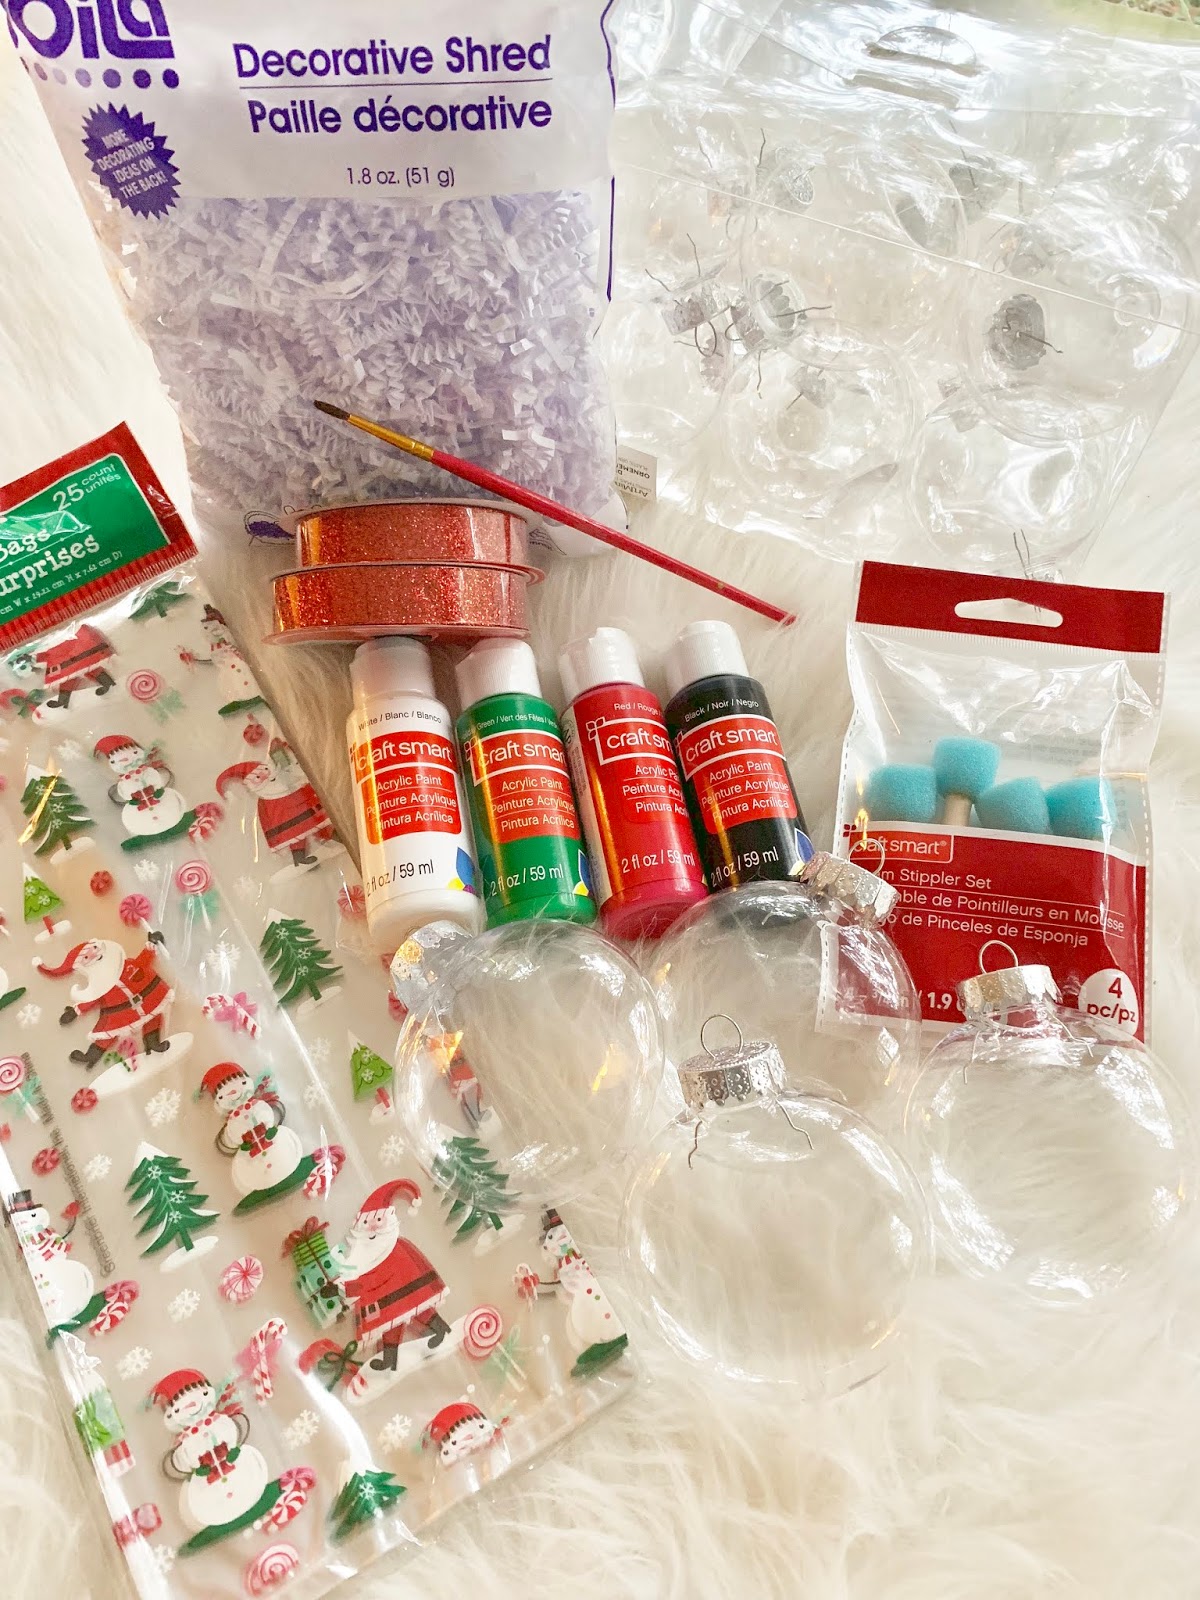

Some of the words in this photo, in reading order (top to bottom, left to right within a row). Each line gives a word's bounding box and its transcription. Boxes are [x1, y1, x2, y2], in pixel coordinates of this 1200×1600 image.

[233, 38, 433, 78] Decorative
[445, 35, 552, 72] Shred
[248, 99, 342, 133] Paille
[353, 96, 552, 132] décorative
[102, 129, 129, 149] MORE
[97, 136, 155, 171] DECORATING
[113, 163, 141, 183] IDEAS
[139, 155, 157, 172] ON
[347, 167, 372, 185] 1.8
[376, 171, 400, 184] oz.
[405, 167, 429, 188] (51
[437, 166, 455, 188] g)
[119, 182, 141, 198] THE
[138, 170, 168, 192] BACK!
[81, 463, 116, 486] count
[85, 473, 122, 493] unités
[53, 482, 84, 510] 25
[52, 580, 65, 589] cm
[99, 558, 112, 567] cm
[385, 711, 409, 720] Blanc
[416, 711, 442, 723] Blanco
[477, 719, 495, 730] Green
[500, 715, 514, 723] Vert
[515, 713, 528, 721] des
[684, 707, 705, 722] Black
[712, 700, 729, 710] Noir
[736, 699, 759, 708] Negro
[607, 728, 652, 749] craft
[686, 730, 725, 762] craft
[726, 728, 778, 745] smart
[356, 740, 396, 771] caft
[399, 741, 452, 762] smart
[479, 740, 521, 767] craft
[523, 743, 566, 767] smar
[636, 764, 668, 777] Acrylic
[709, 763, 744, 783] Acrylic
[747, 760, 773, 771] Paint
[377, 775, 412, 793] Acrylic
[415, 774, 442, 786] Paint
[502, 777, 537, 792] Acrylic
[540, 777, 563, 790] Paint
[622, 784, 666, 796] Peinture
[701, 784, 742, 808] Peinture
[745, 779, 789, 792] Acrylique
[366, 795, 407, 818] Penture
[410, 792, 457, 808] Acrylique
[492, 797, 534, 814] Peinture
[636, 802, 672, 813] Pintura
[501, 815, 539, 832] Pintura
[853, 836, 888, 852] caft
[622, 858, 630, 873] 2
[632, 855, 640, 869] fl
[643, 854, 658, 866] oz
[668, 851, 681, 864] 59
[684, 853, 695, 866] ml
[711, 873, 717, 887] 2
[716, 867, 722, 881] fl
[723, 863, 736, 877] oz
[743, 851, 759, 868] 59
[763, 846, 779, 862] ml
[366, 882, 371, 897] 2
[371, 876, 377, 892] fl
[378, 872, 390, 887] oz
[399, 862, 415, 878] 59
[418, 859, 434, 875] ml
[491, 881, 497, 897] 2
[498, 875, 505, 892] fl
[506, 874, 521, 888] oz
[530, 866, 546, 881] 59
[549, 863, 564, 878] ml
[900, 868, 960, 886] Stippler
[965, 874, 991, 890] Set
[932, 893, 952, 907] de
[957, 896, 1043, 918] Pointilleurs
[1049, 910, 1069, 921] en
[902, 912, 922, 926] de
[928, 914, 992, 934] Pinceles
[997, 923, 1019, 937] de
[1023, 926, 1088, 948] Esponja
[1108, 977, 1123, 999] 4
[928, 992, 953, 1010] 1.9
